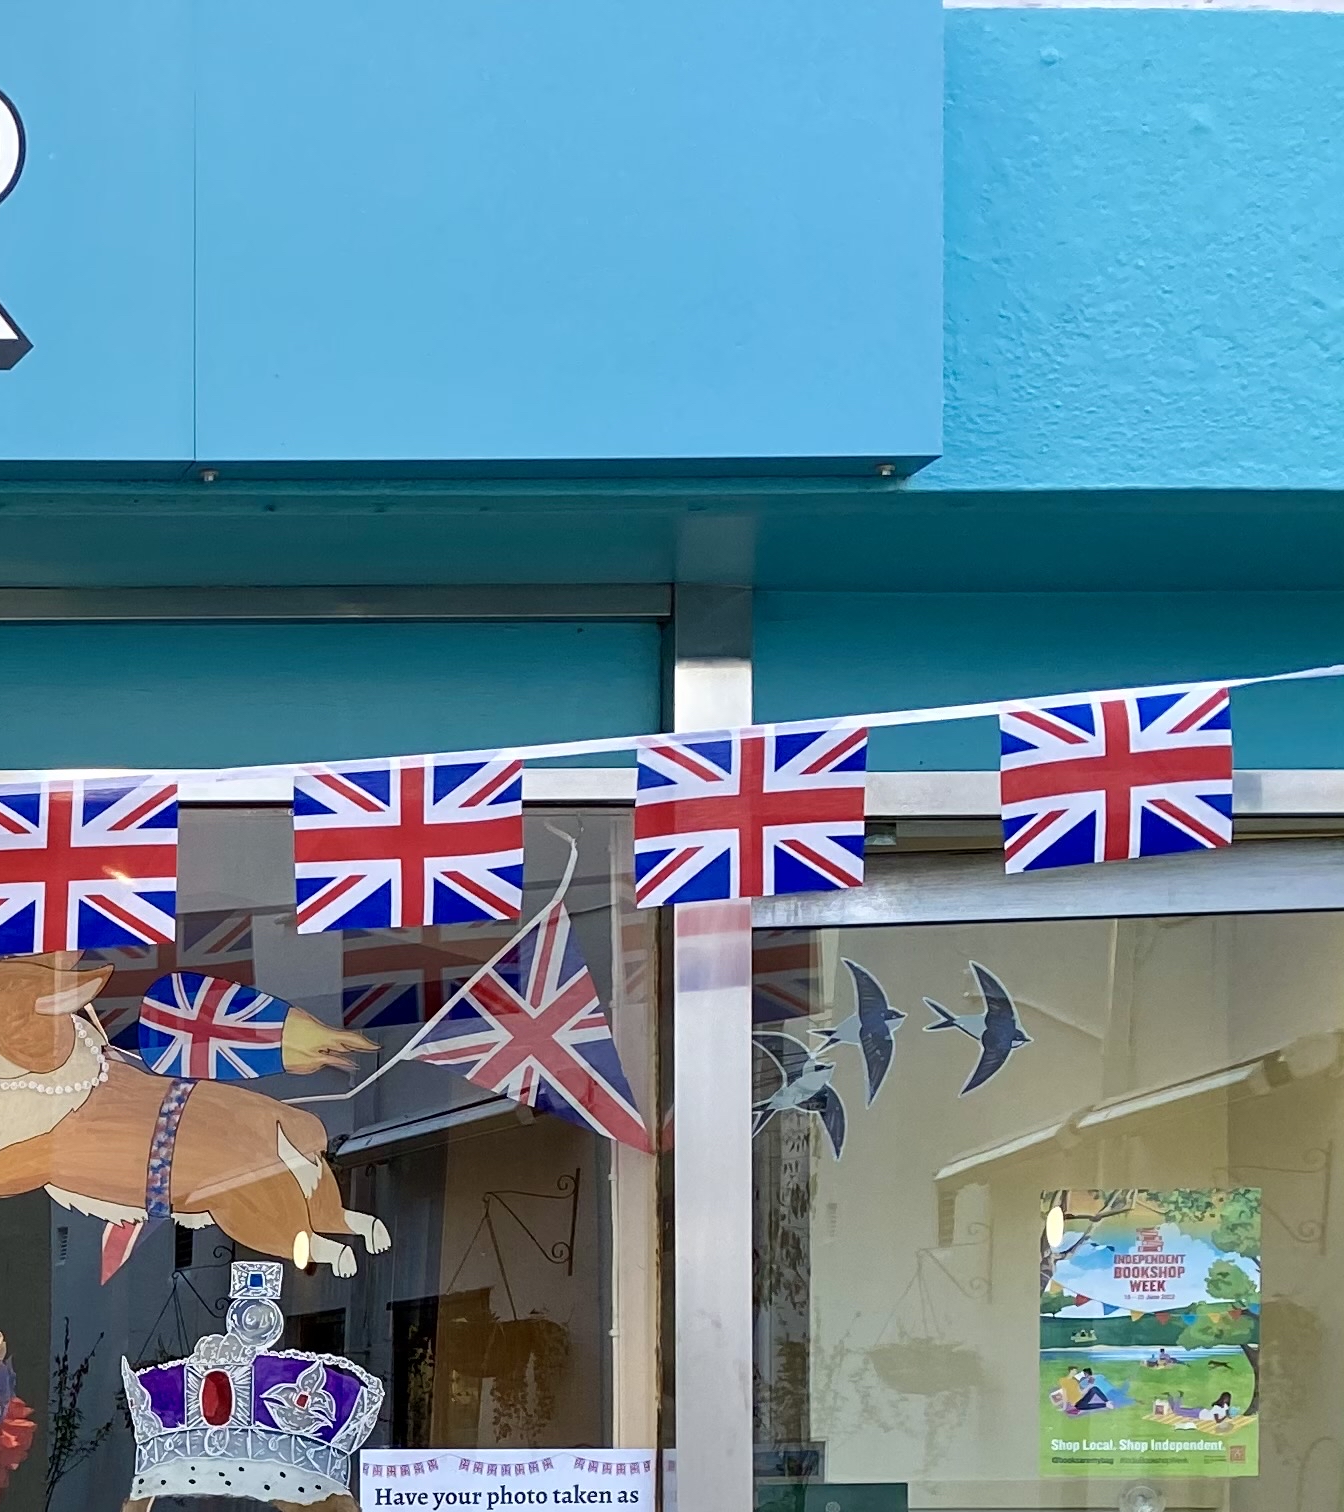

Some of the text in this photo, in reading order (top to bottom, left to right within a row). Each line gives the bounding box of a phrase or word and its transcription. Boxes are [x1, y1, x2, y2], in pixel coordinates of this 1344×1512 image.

[1113, 1254, 1186, 1264] INDEPENDENT
[1113, 1266, 1185, 1279] BOOKSHOP
[1130, 1280, 1166, 1292] WEEK
[1051, 1439, 1226, 1452] Shop Local. Shop Independent.
[375, 1484, 639, 1510] Have your photo taken as
